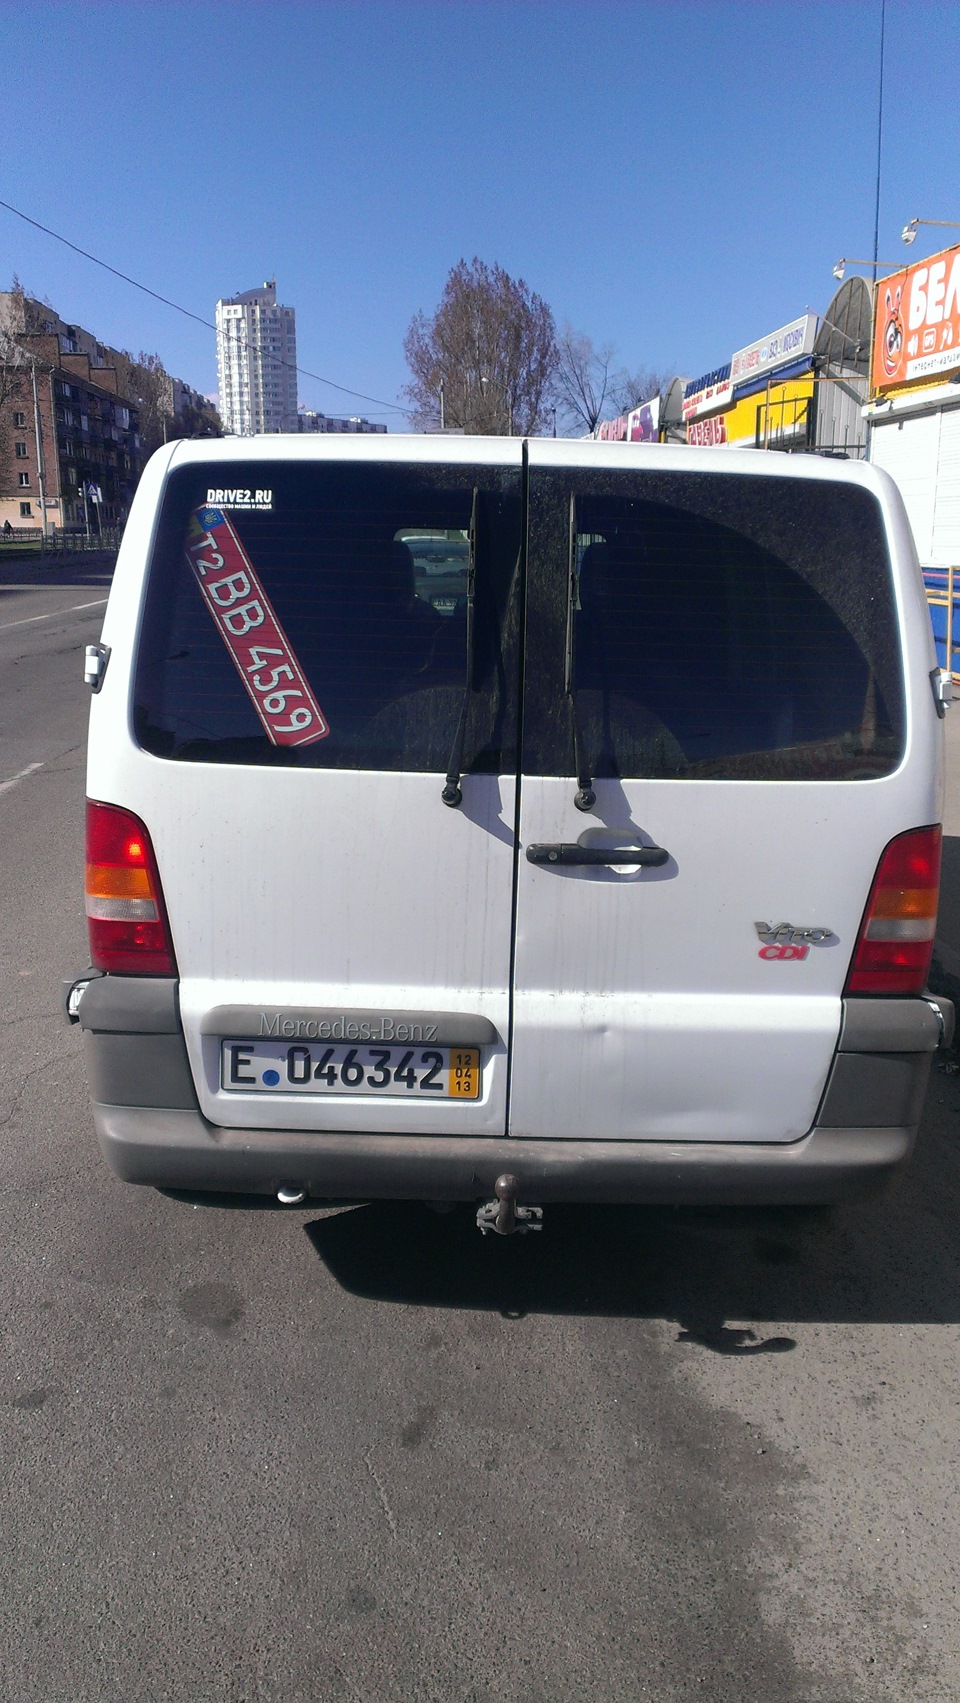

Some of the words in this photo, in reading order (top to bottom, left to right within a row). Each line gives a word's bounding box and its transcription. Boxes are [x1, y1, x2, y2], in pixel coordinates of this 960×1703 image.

[206, 489, 272, 503] DRIVE2.RU
[247, 645, 313, 733] 4569
[758, 945, 810, 960] CDI
[258, 1012, 439, 1043] Mercedes-Benz
[456, 1054, 472, 1065] 12
[286, 1047, 444, 1090] 046342
[455, 1068, 472, 1079] 04
[456, 1081, 471, 1092] 13
